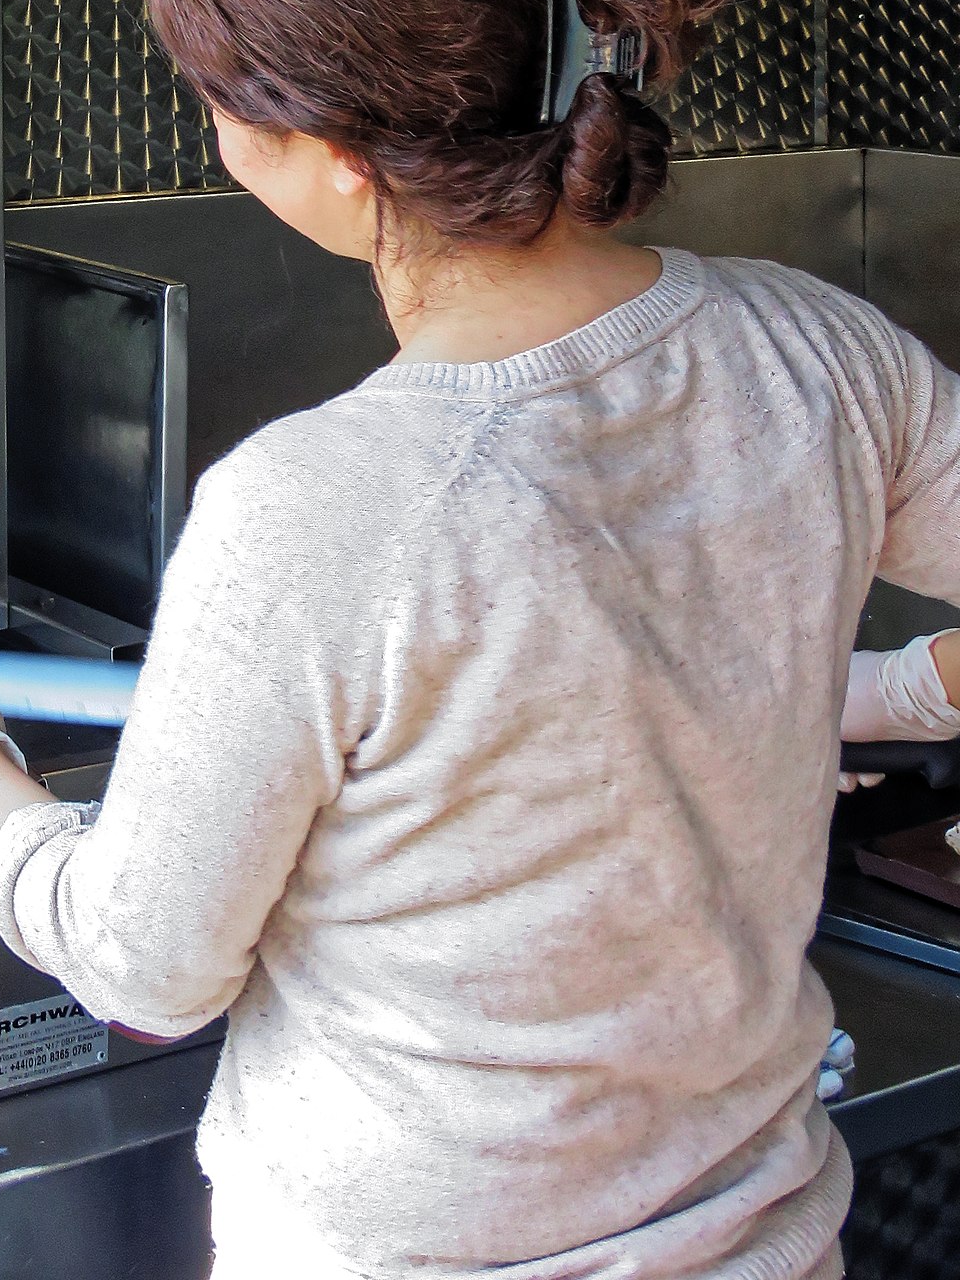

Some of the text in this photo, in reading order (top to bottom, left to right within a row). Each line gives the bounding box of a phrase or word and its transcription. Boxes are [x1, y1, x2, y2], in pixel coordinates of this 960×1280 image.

[77, 1030, 105, 1042] ENGLAND
[10, 1054, 47, 1072] +44(0)20
[49, 1047, 70, 1062] 8365
[72, 1042, 93, 1057] 0760
